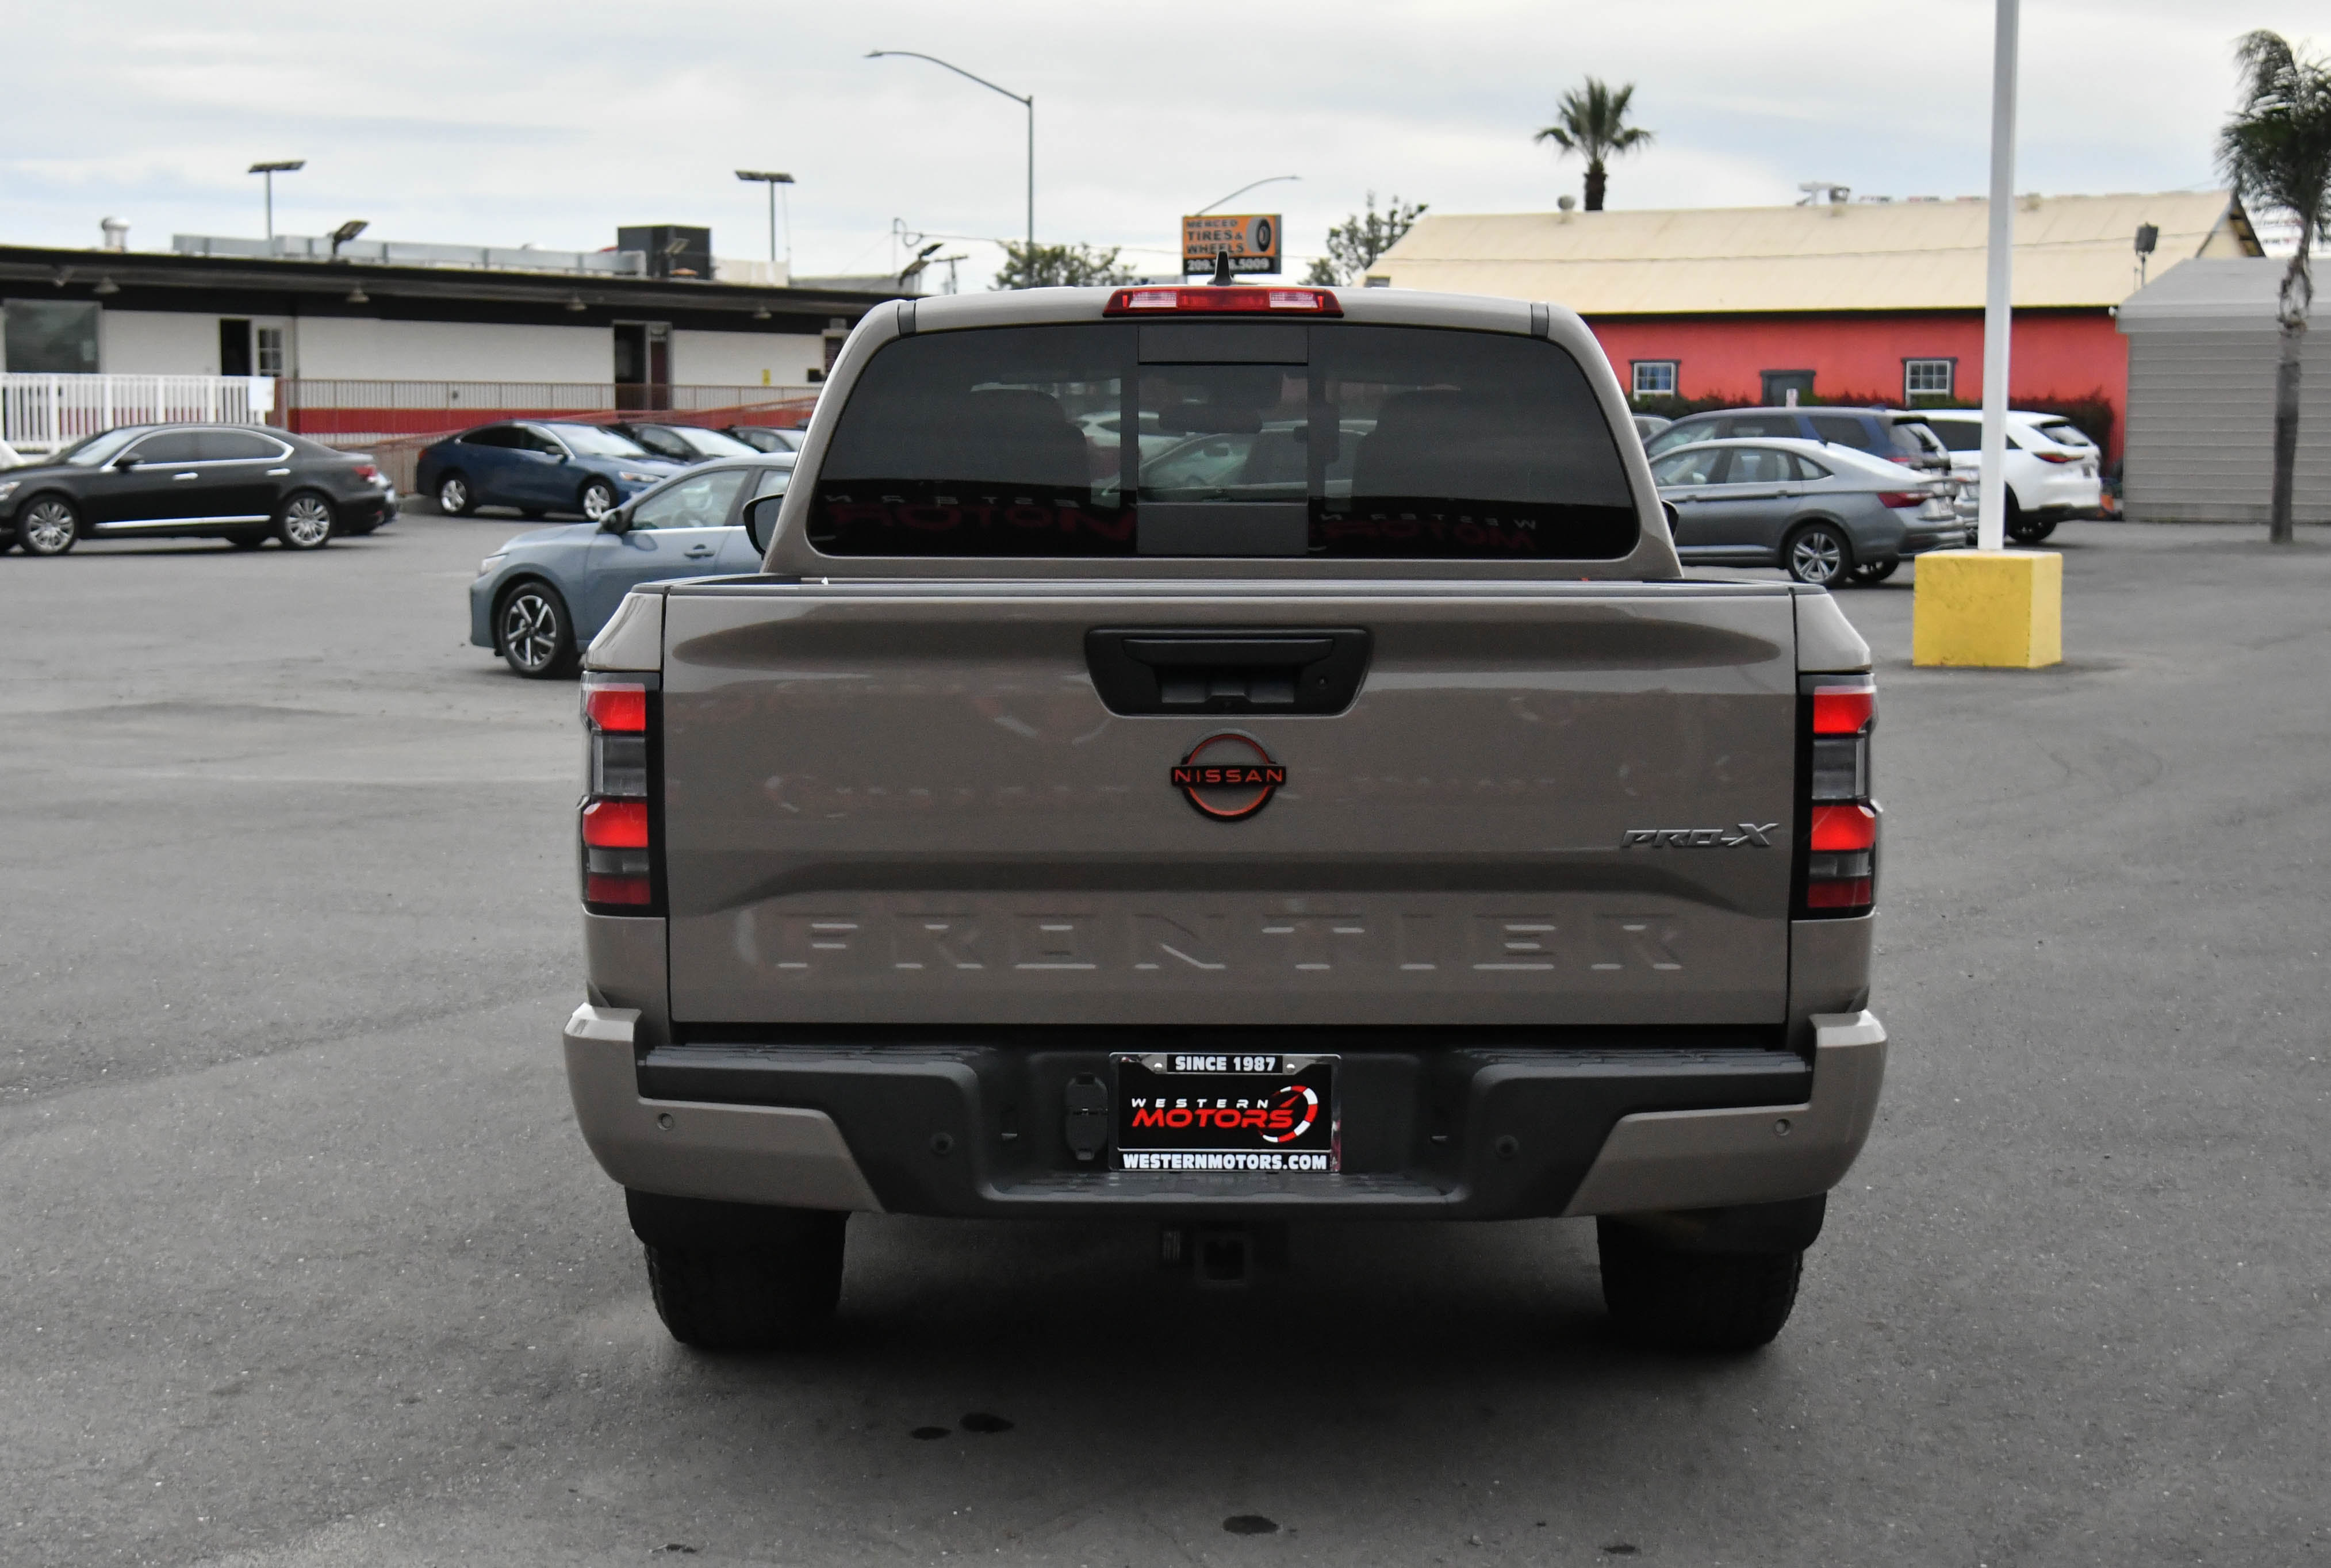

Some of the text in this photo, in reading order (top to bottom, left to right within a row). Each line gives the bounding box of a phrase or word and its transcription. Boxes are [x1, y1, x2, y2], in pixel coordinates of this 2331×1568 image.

[1187, 219, 1238, 228] MERCED
[1187, 230, 1232, 241] TIRES
[1187, 243, 1245, 254] WHEELS
[1175, 768, 1283, 783] NISSAN
[1620, 823, 1779, 847] PRO-X
[776, 914, 1682, 970] FRONTIER
[1175, 1056, 1276, 1072] SINCE 1987
[1131, 1098, 1268, 1109] WESTERN
[1132, 1107, 1294, 1129] MOTORS
[1123, 1153, 1327, 1170] WESTERNMOTORS.COM
